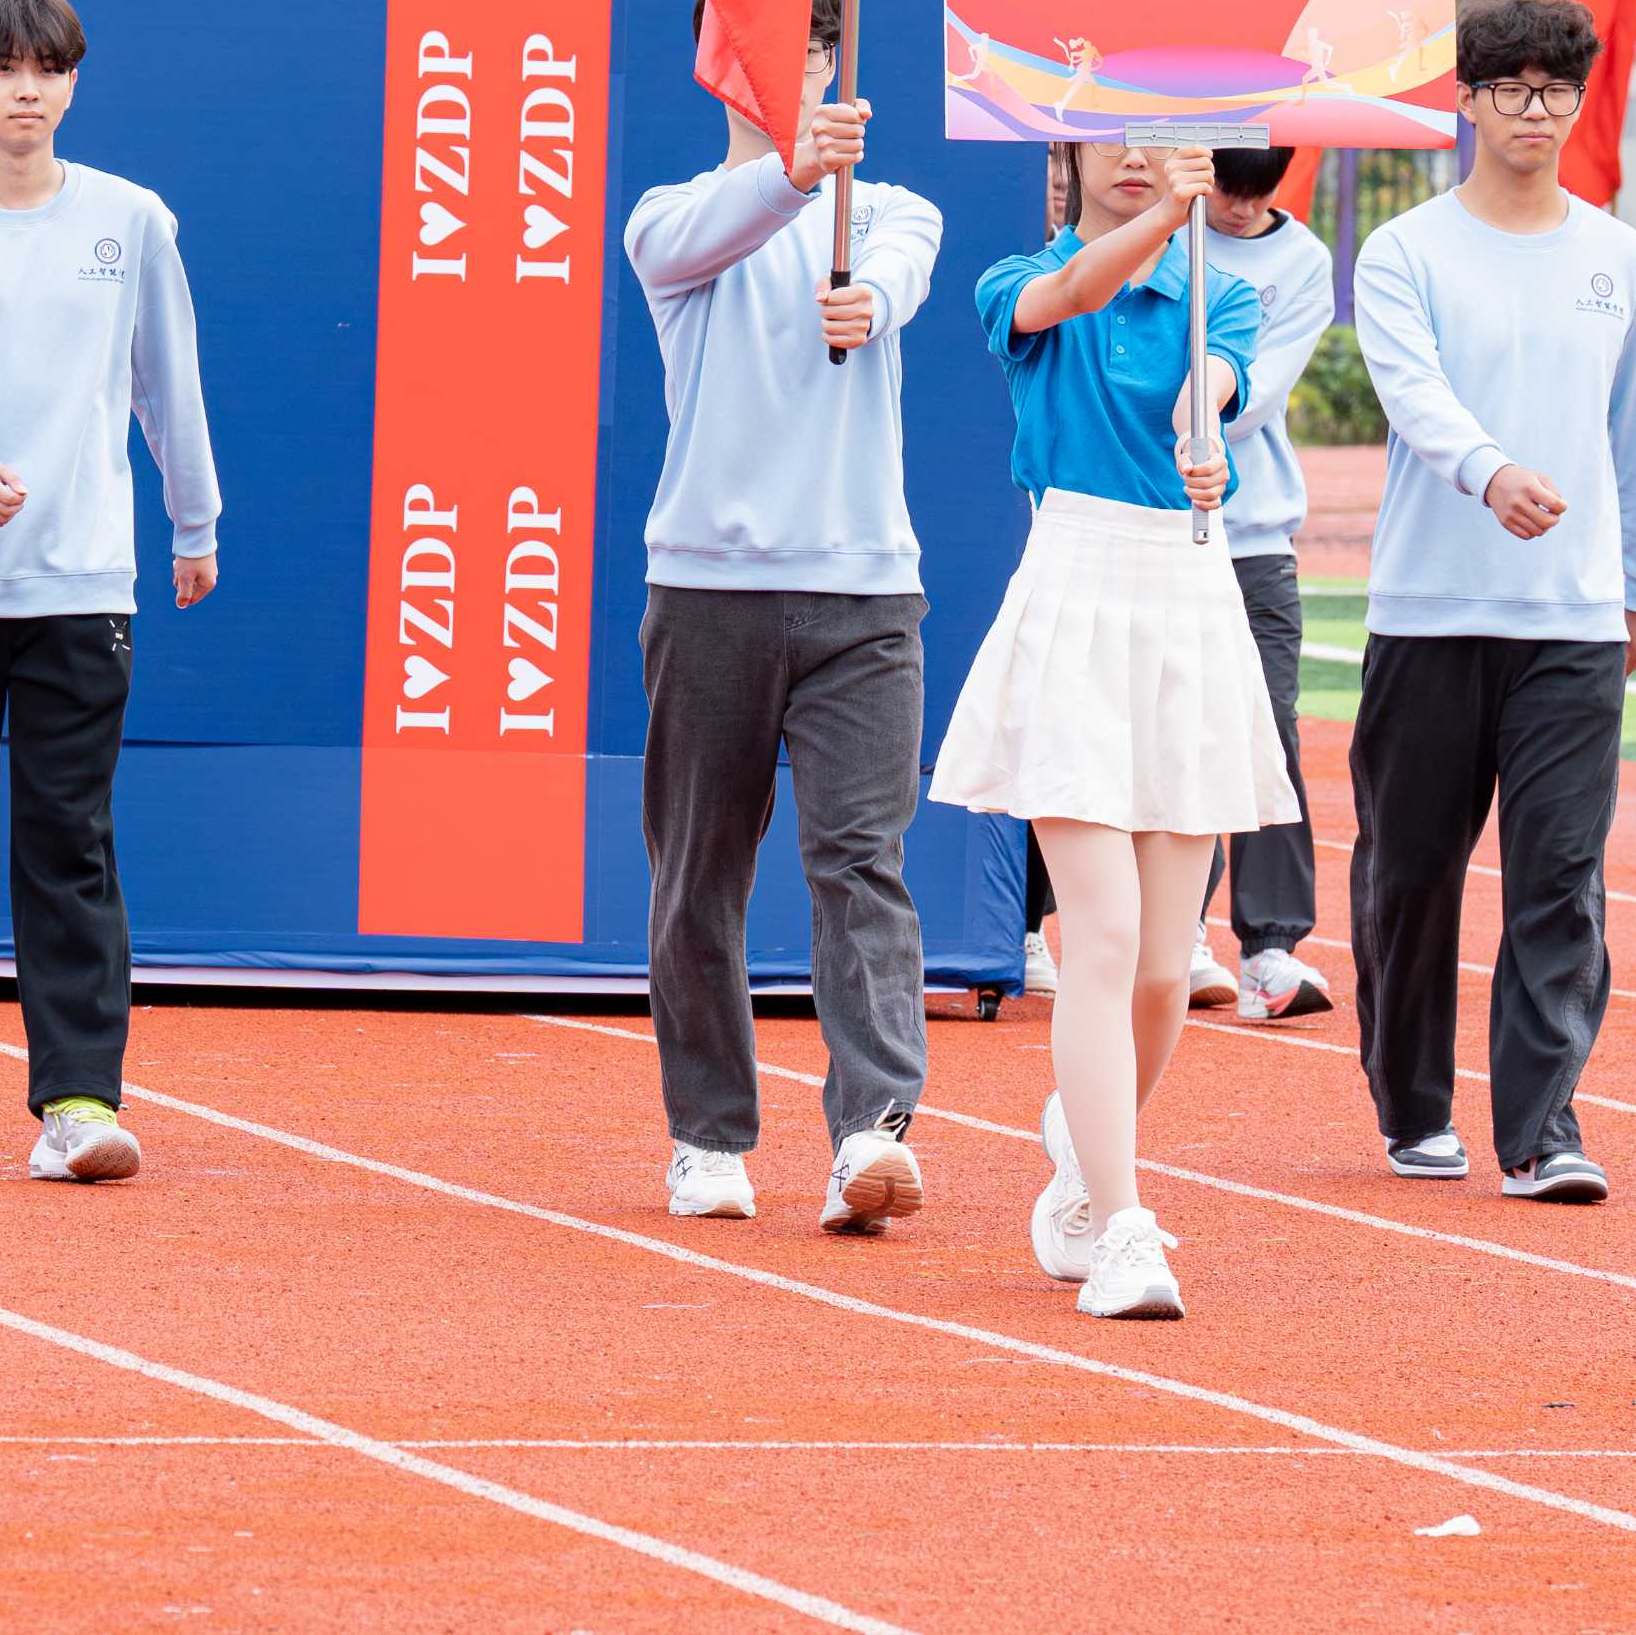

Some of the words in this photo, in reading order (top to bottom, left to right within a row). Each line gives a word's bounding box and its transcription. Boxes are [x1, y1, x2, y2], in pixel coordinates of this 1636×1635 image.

[414, 29, 473, 197] ZDP
[518, 33, 577, 199] ZDP
[398, 483, 458, 650] ZDP
[502, 485, 562, 652] ZDP
